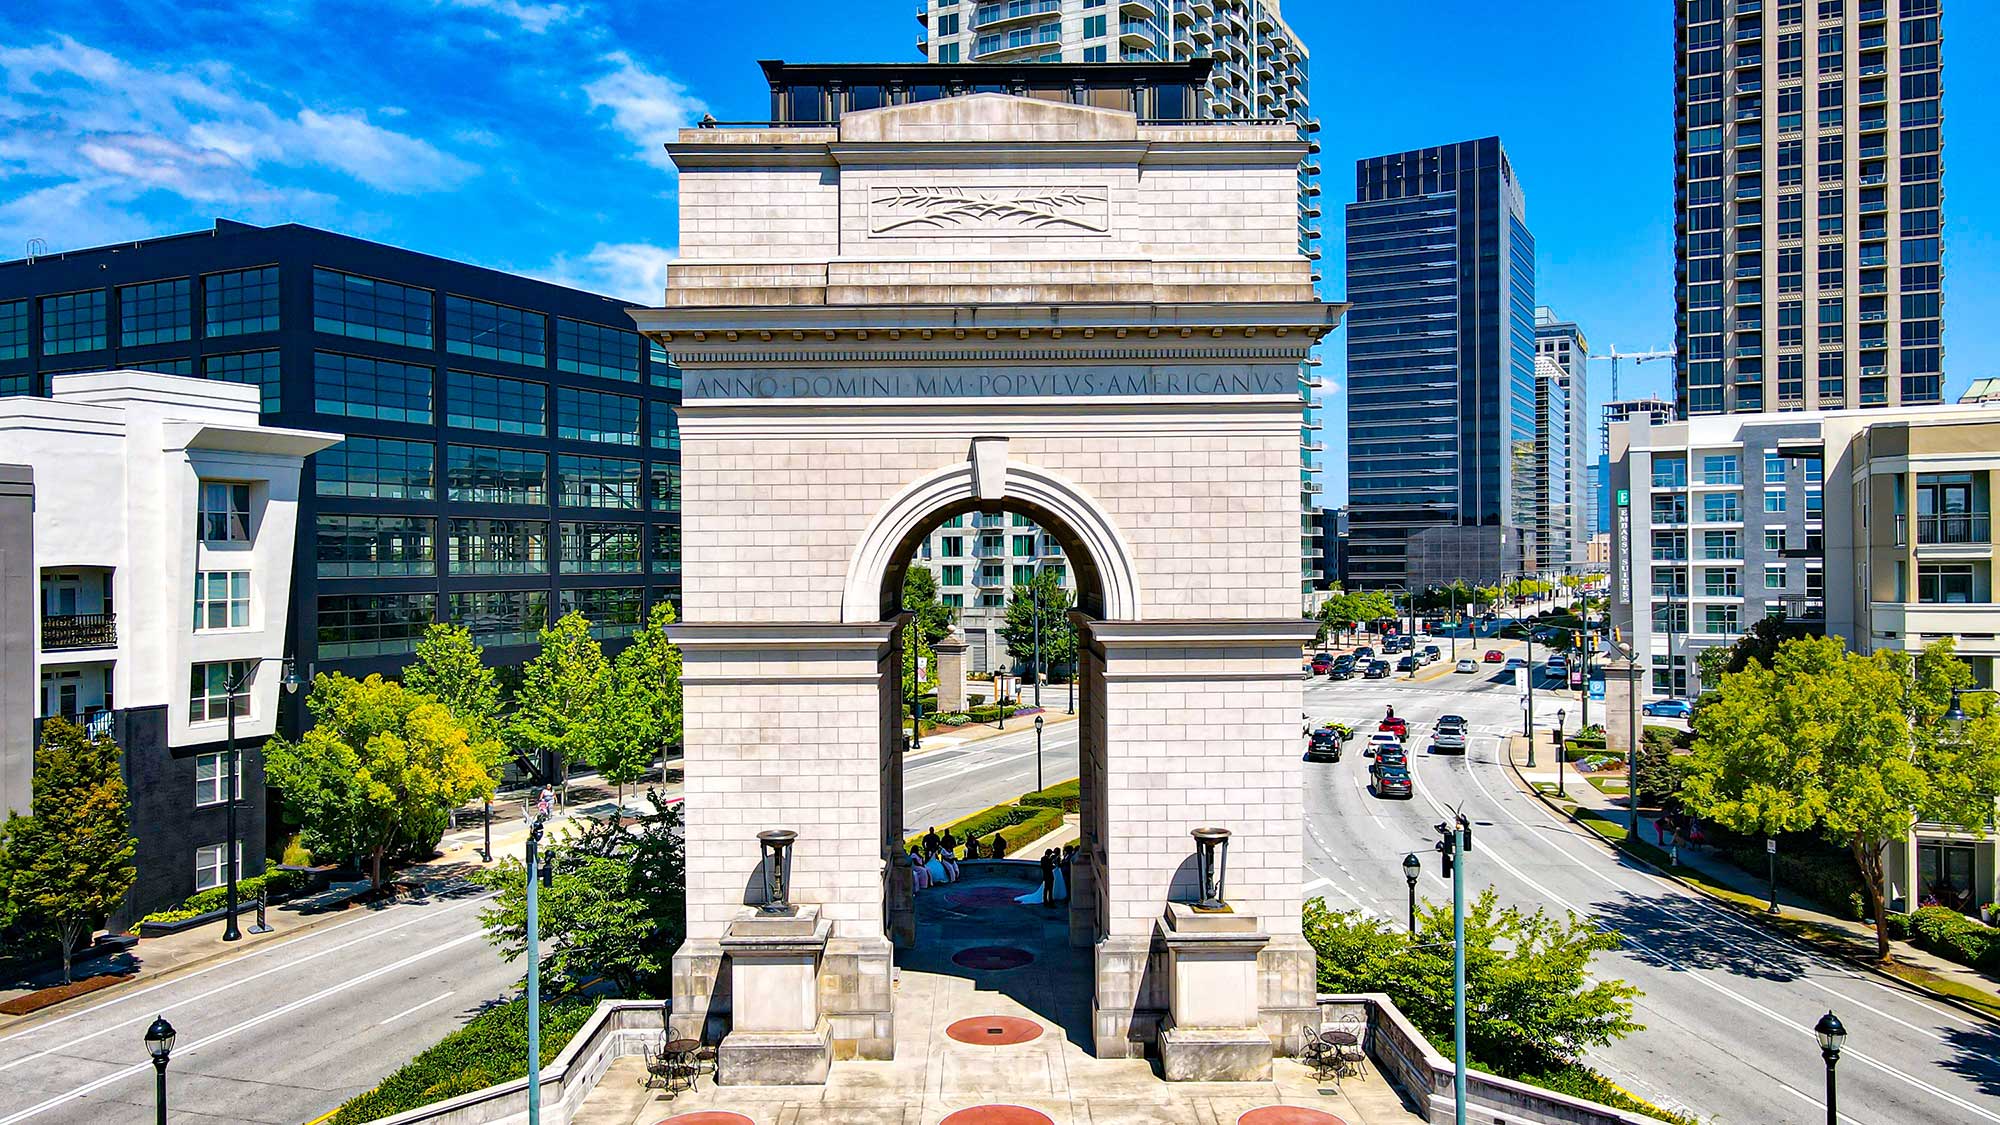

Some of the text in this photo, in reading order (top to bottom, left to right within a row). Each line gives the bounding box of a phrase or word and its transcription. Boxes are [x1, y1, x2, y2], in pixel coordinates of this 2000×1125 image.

[694, 372, 1284, 398] ANNO DOMINI MM POPVLVS AMERICANVS
[1620, 509, 1629, 598] EMBASSY SUITES
